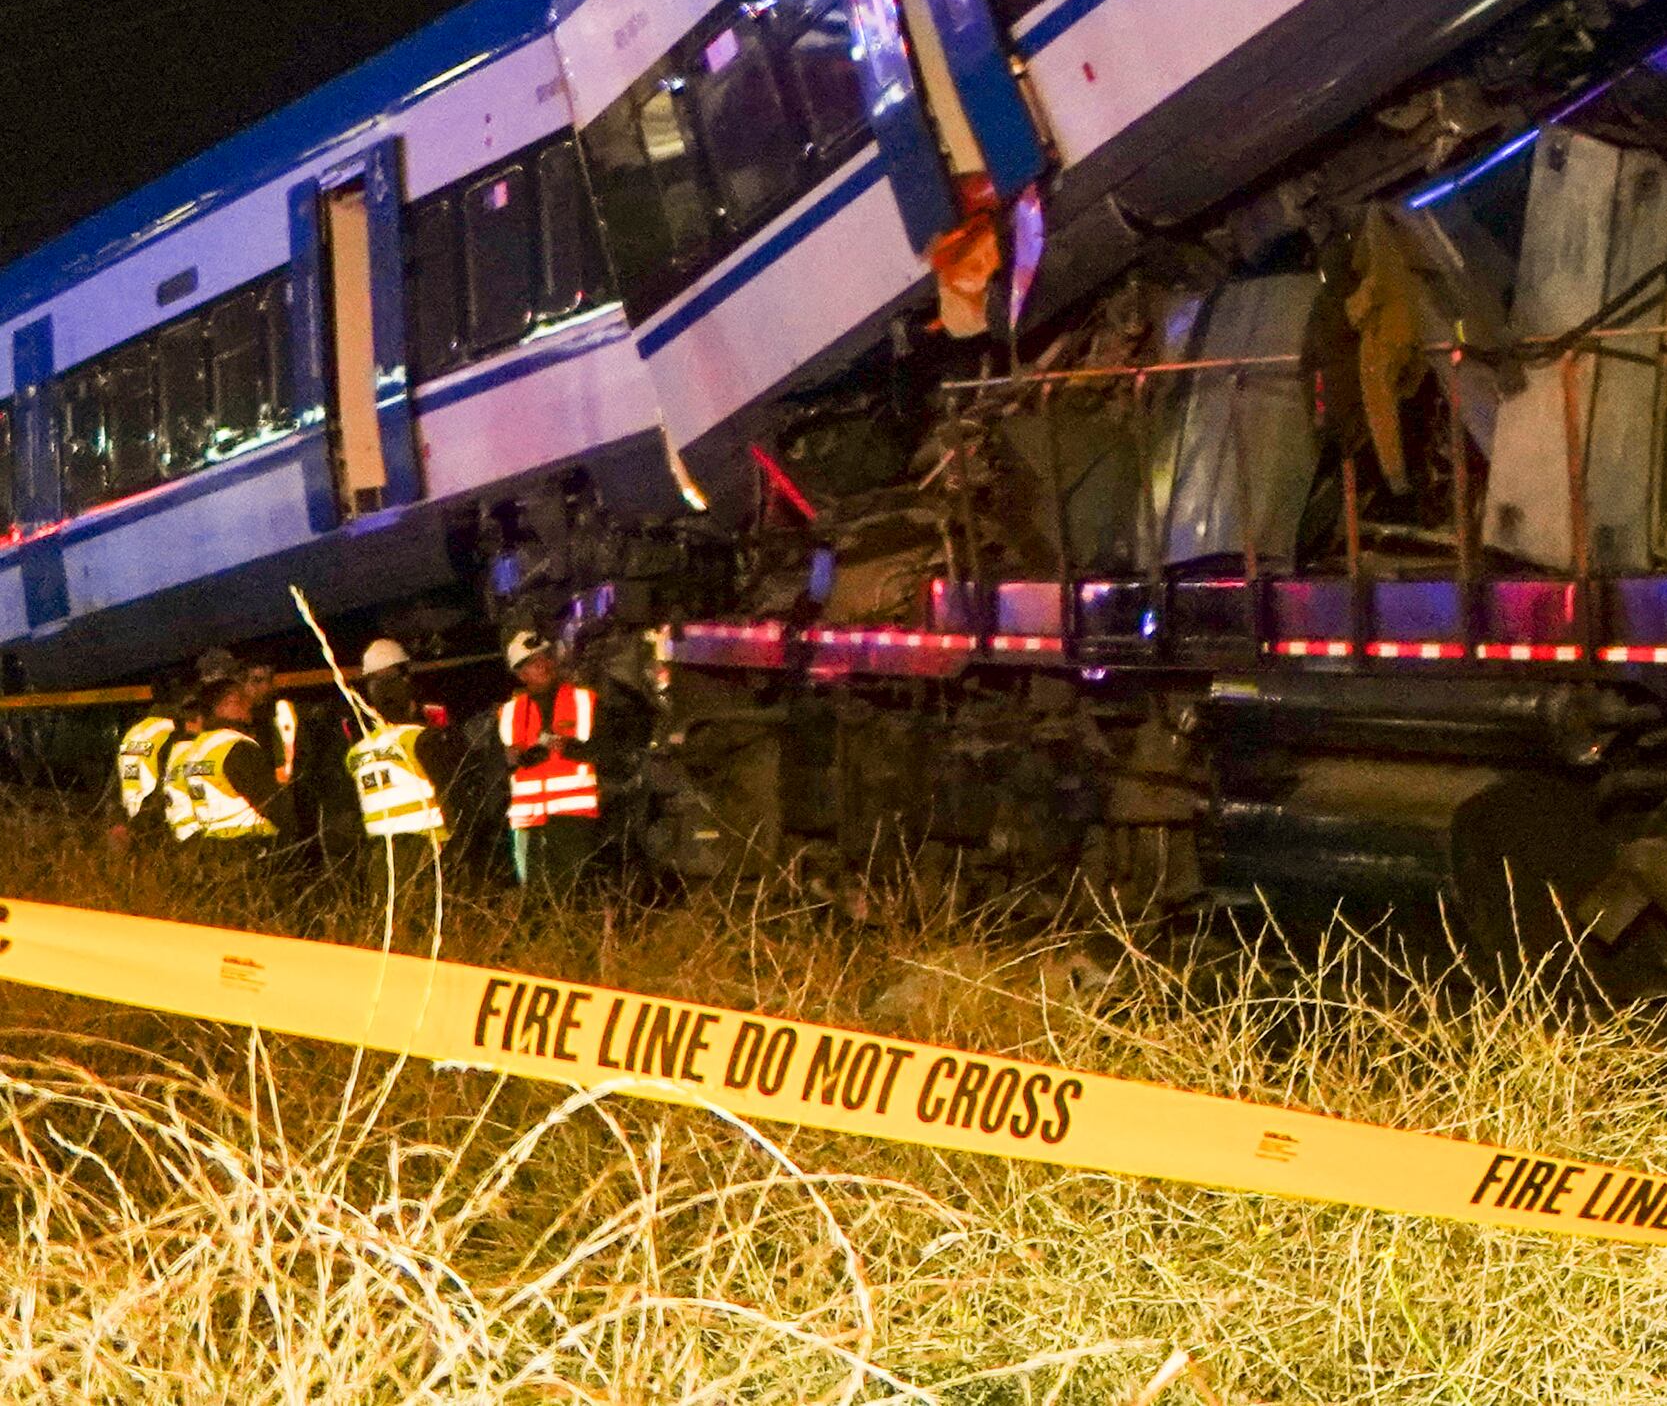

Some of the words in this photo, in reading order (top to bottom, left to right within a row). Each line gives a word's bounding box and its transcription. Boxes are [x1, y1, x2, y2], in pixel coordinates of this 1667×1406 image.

[474, 977, 592, 1061] FIRE
[598, 998, 721, 1083] LINE
[723, 1019, 797, 1096] DO
[800, 1034, 915, 1115] NOT
[916, 1055, 1083, 1145] CROSS
[1470, 1153, 1585, 1216] FIRE
